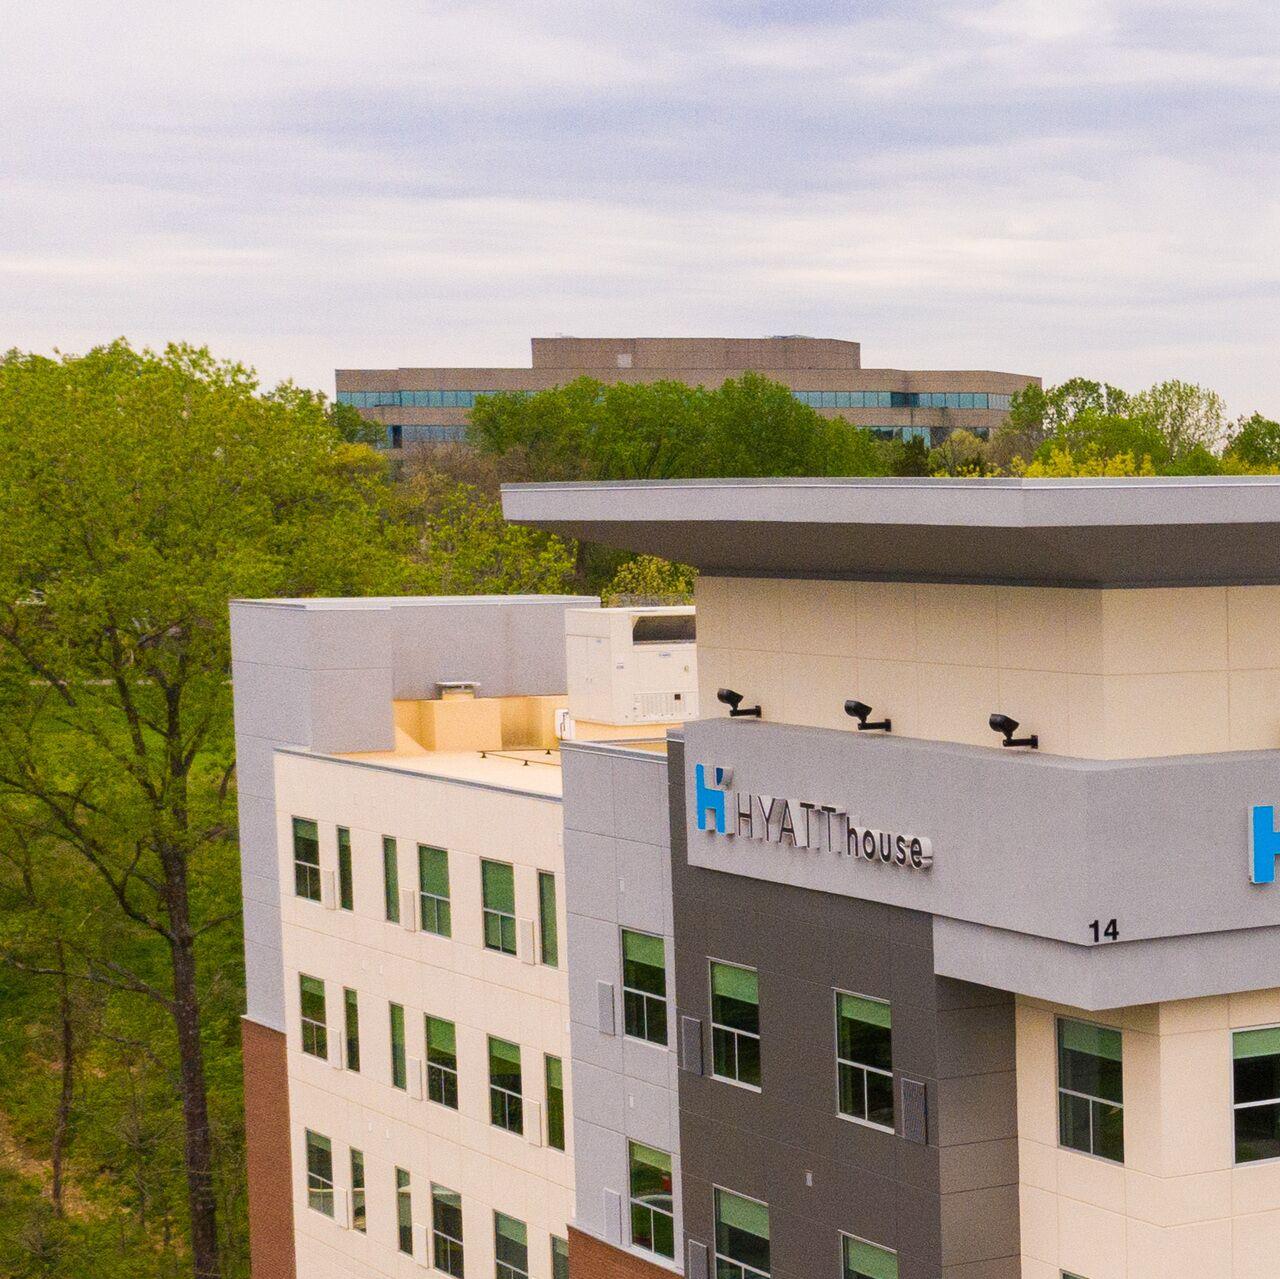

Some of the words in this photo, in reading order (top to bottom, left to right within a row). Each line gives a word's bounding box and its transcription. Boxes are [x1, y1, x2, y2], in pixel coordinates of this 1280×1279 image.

[736, 792, 841, 853] HYATT
[846, 816, 926, 870] house
[1088, 918, 1120, 943] 14
